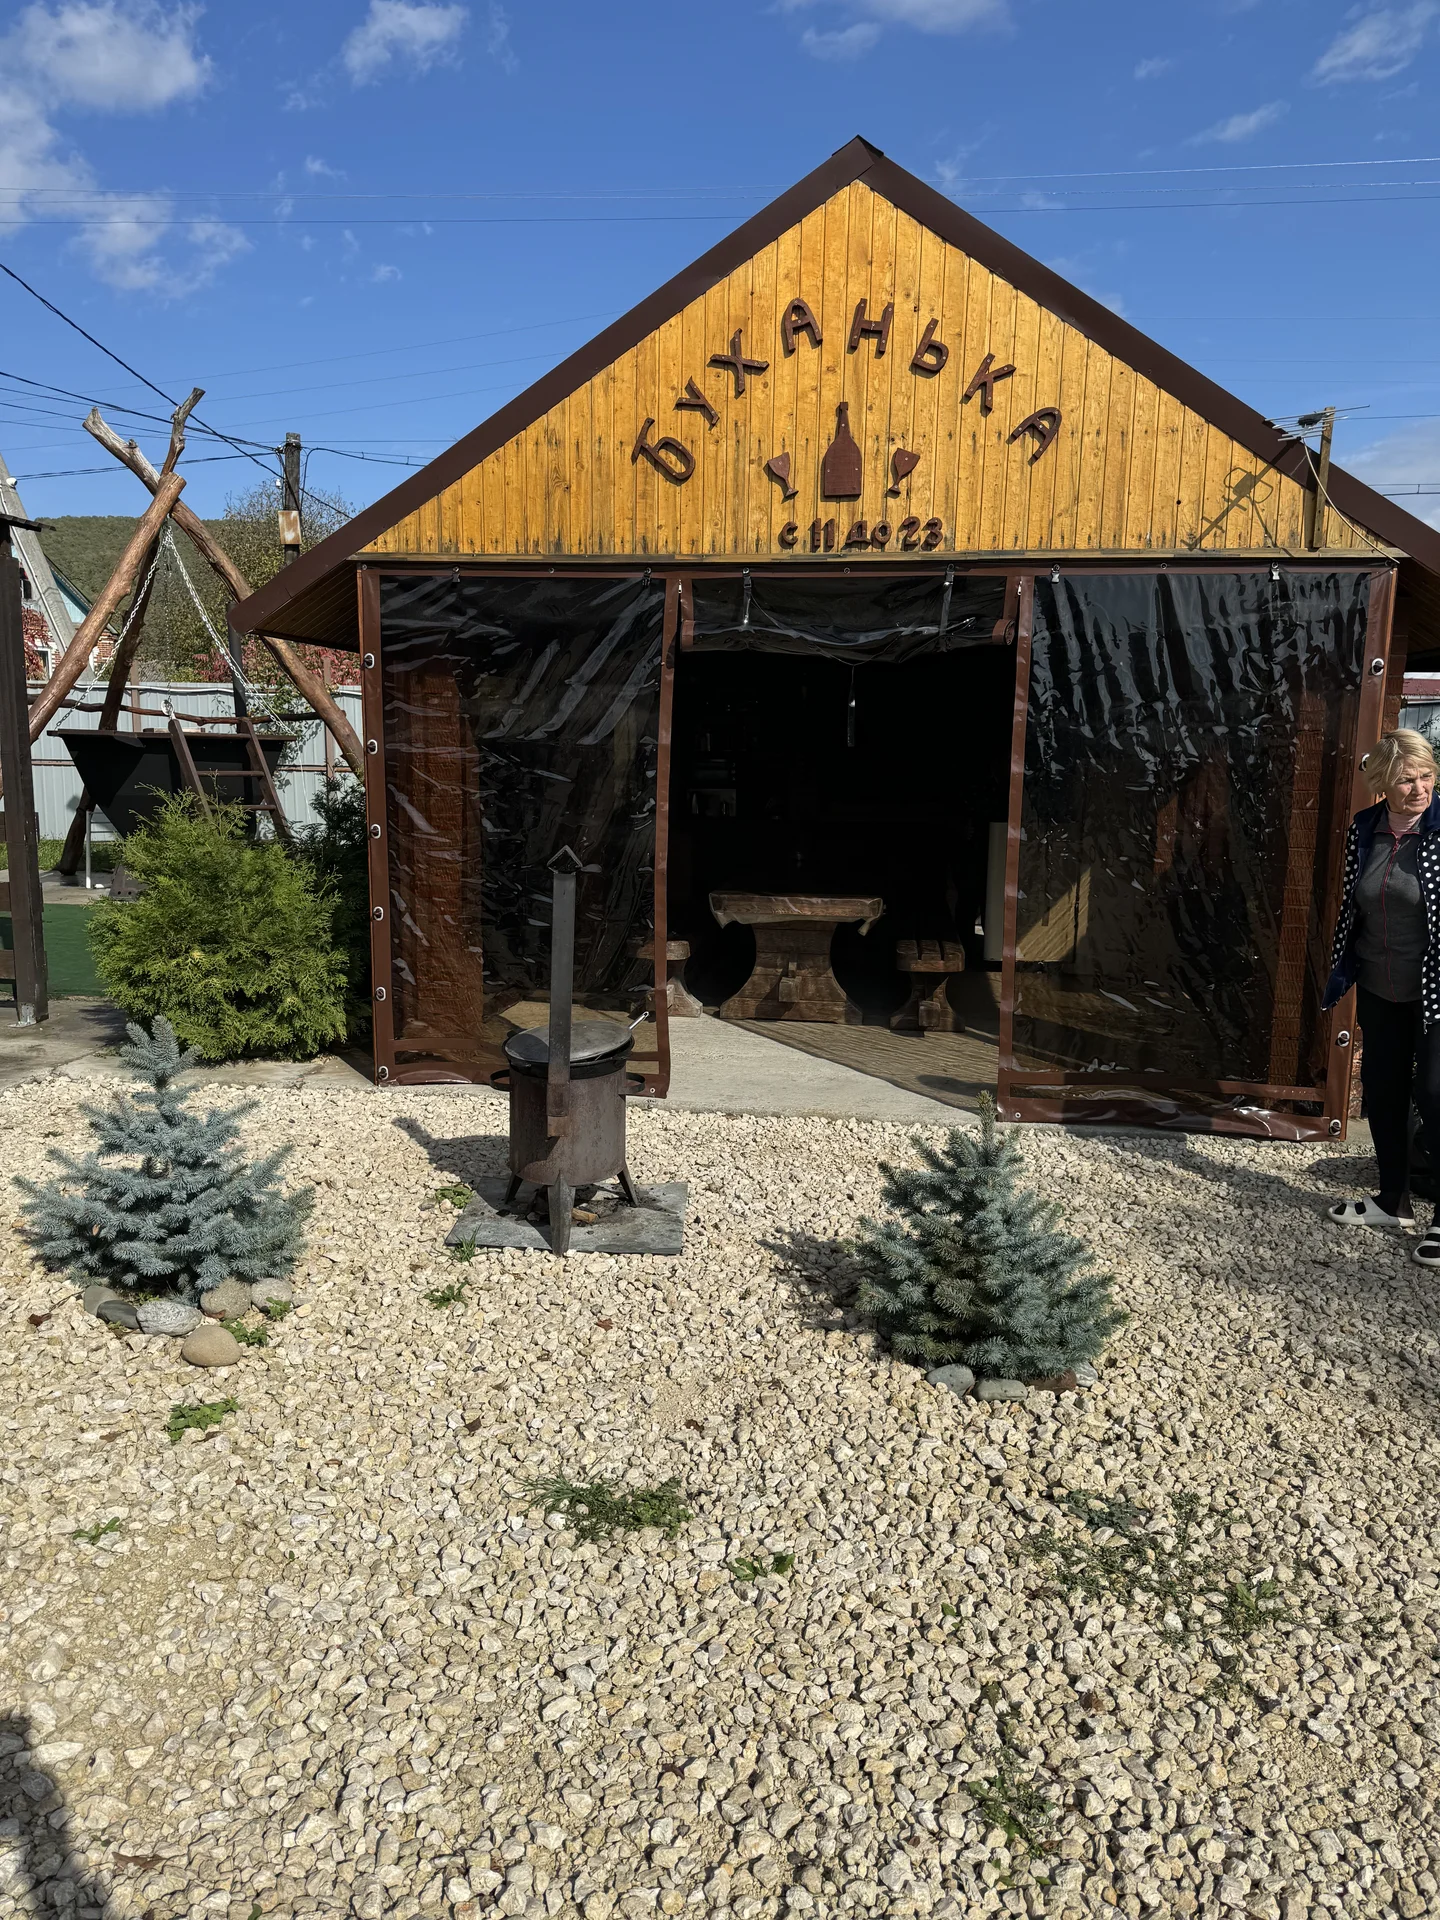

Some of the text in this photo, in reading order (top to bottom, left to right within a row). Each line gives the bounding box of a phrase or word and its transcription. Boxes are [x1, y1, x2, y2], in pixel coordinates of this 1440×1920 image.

[631, 297, 1063, 481] БУХАНЬКА
[811, 517, 835, 548] 11
[902, 515, 944, 547] 23
